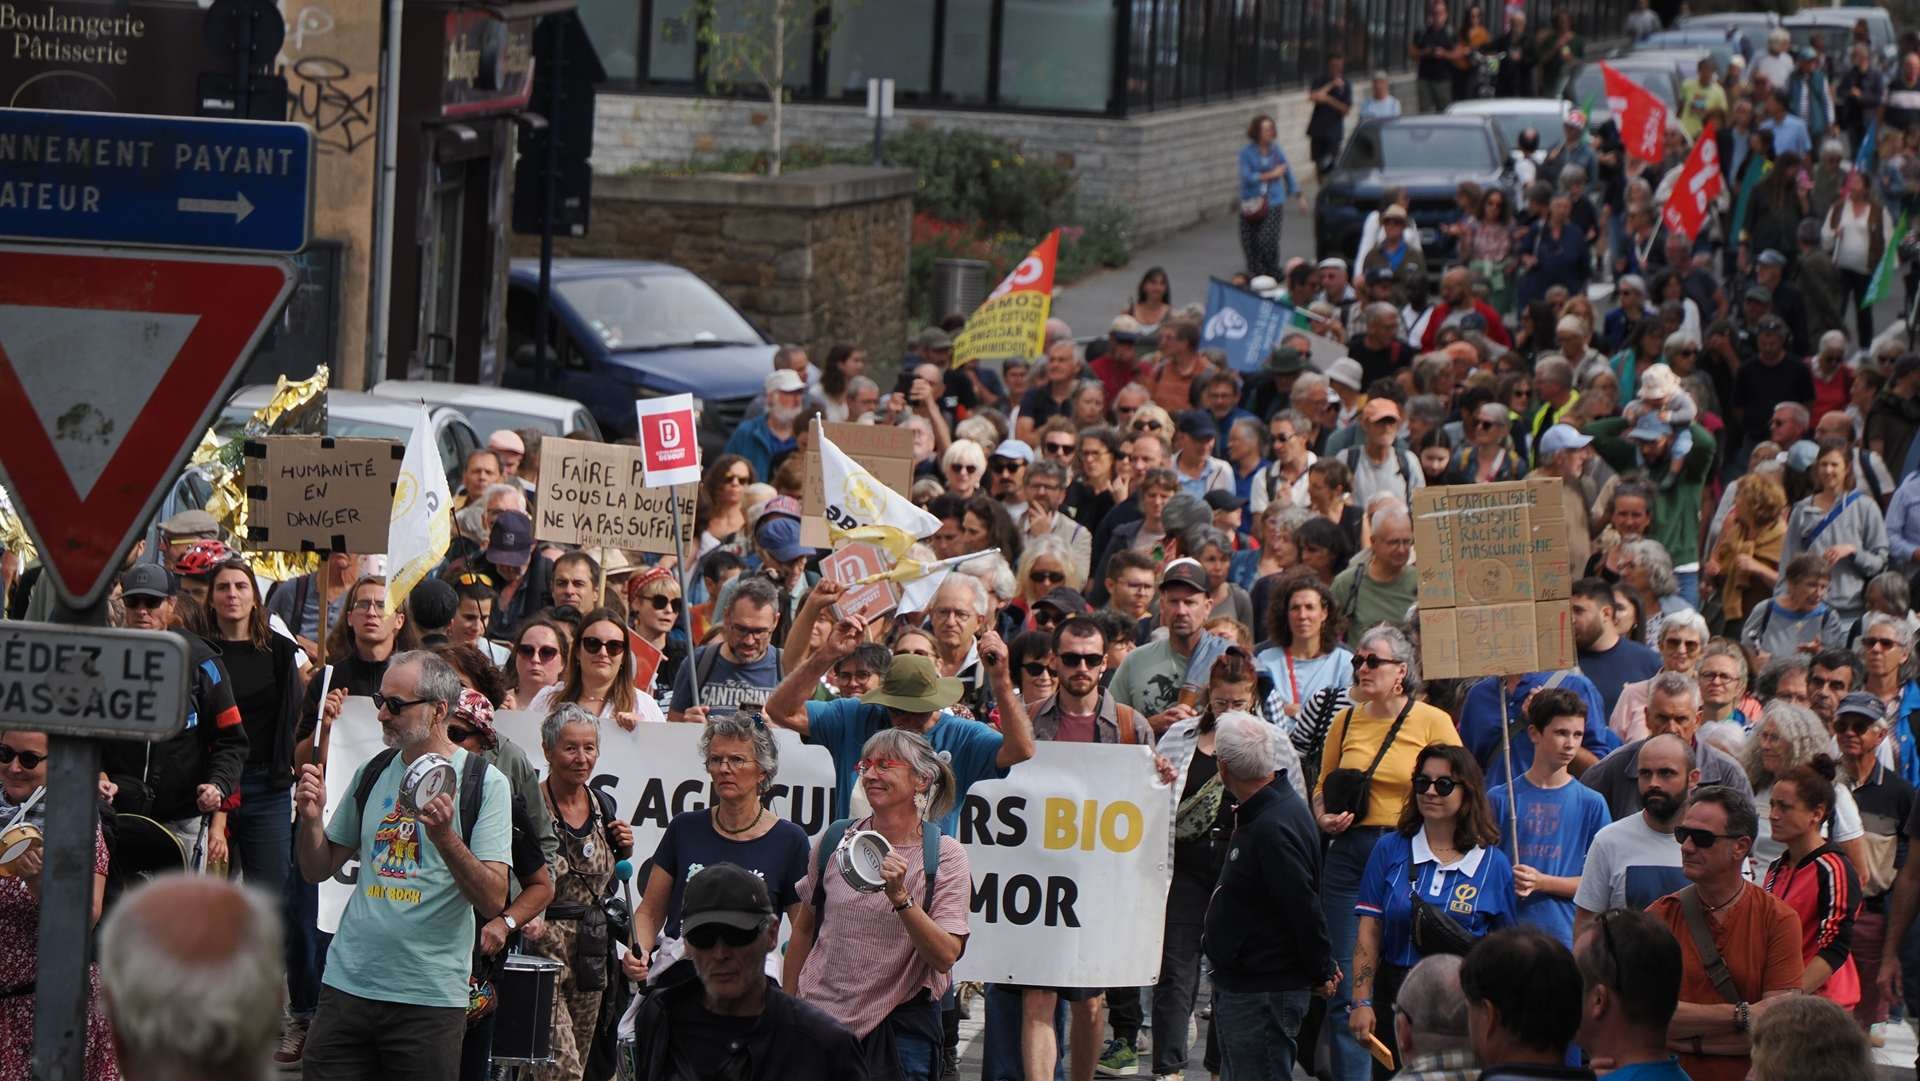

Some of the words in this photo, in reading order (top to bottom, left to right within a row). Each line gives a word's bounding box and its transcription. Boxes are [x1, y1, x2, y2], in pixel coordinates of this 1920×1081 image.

[0, 4, 145, 39] Boulangerie
[12, 33, 128, 65] Pâtisserie
[175, 143, 293, 176] PAYANT
[281, 458, 377, 479] HUMANITÉ
[562, 456, 616, 488] FAIRE
[304, 483, 328, 501] EN
[551, 483, 601, 505] SOUS
[606, 492, 627, 509] LA
[634, 492, 695, 516] DOUCHE
[1433, 496, 1448, 512] LE
[1456, 488, 1537, 508] CAPITALISME
[287, 508, 361, 528] DANGER
[544, 510, 565, 529] NE
[572, 513, 592, 532] VA
[597, 513, 624, 536] PAS
[0, 633, 102, 677] ÉDEZ
[123, 649, 165, 682] LE
[1044, 797, 1144, 853] BIO
